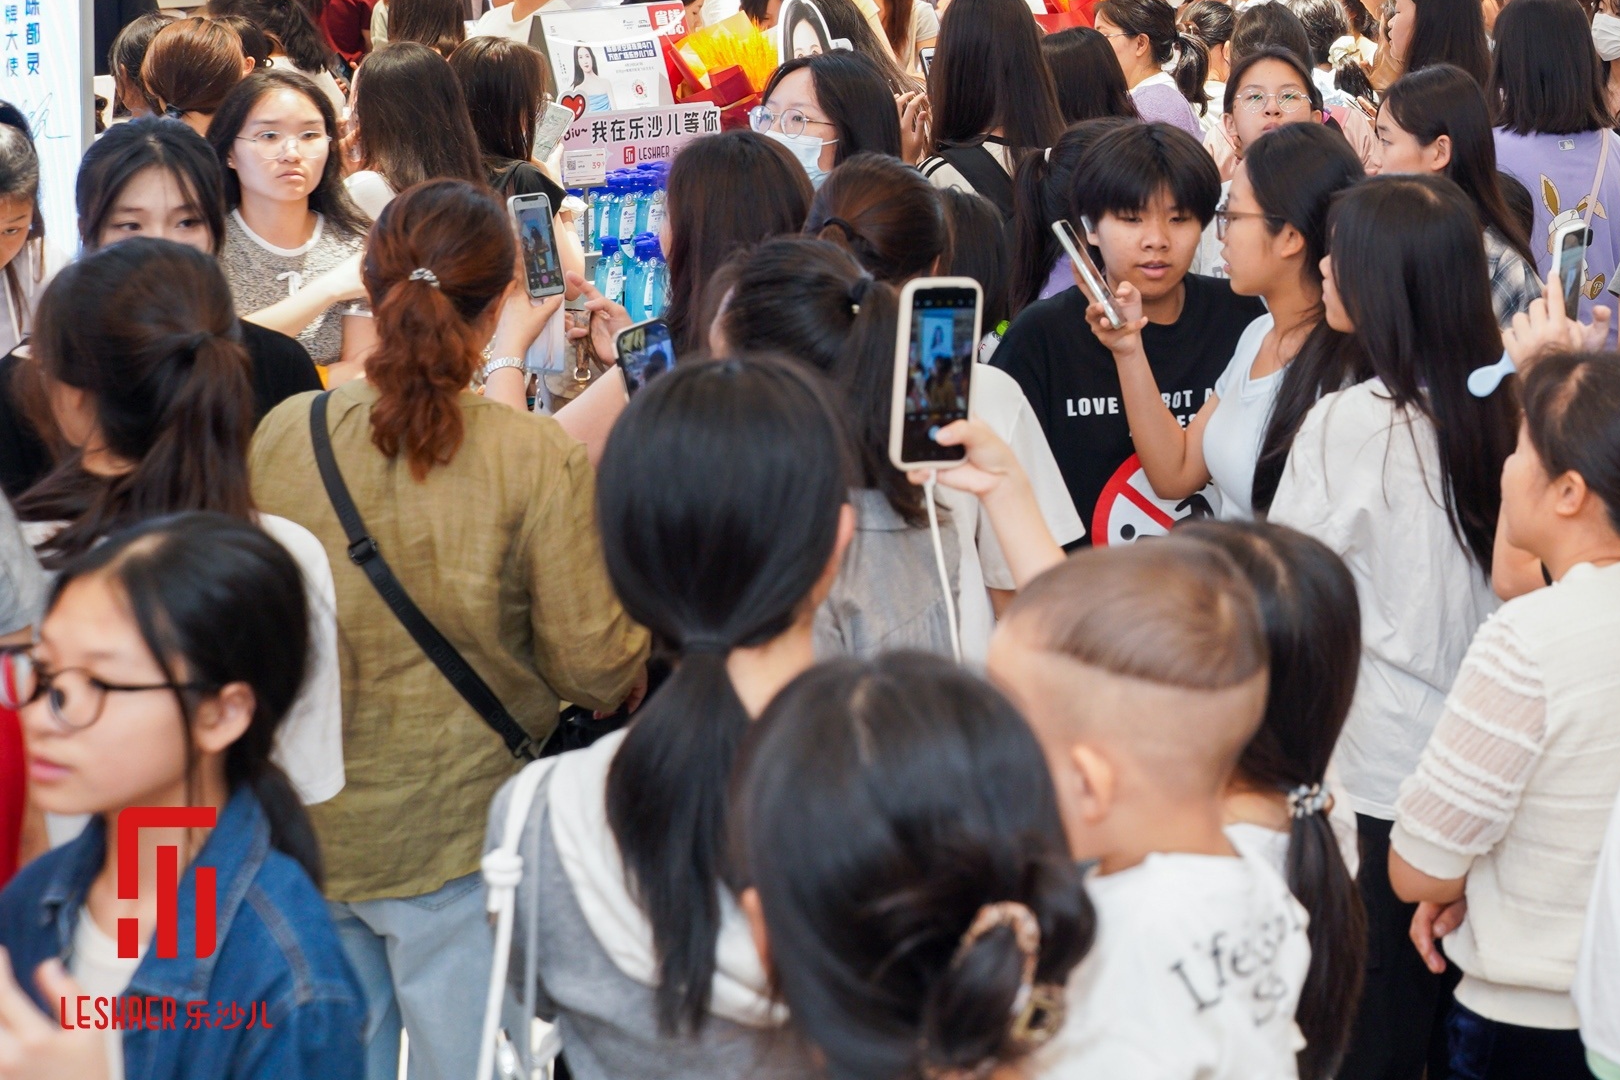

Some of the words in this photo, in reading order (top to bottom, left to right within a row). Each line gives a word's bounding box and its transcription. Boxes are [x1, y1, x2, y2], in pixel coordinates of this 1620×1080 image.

[592, 109, 719, 144] 我在乐沙儿等你
[638, 145, 670, 161] LESHAER
[1066, 396, 1120, 417] LOVE
[1160, 389, 1194, 409] BOT
